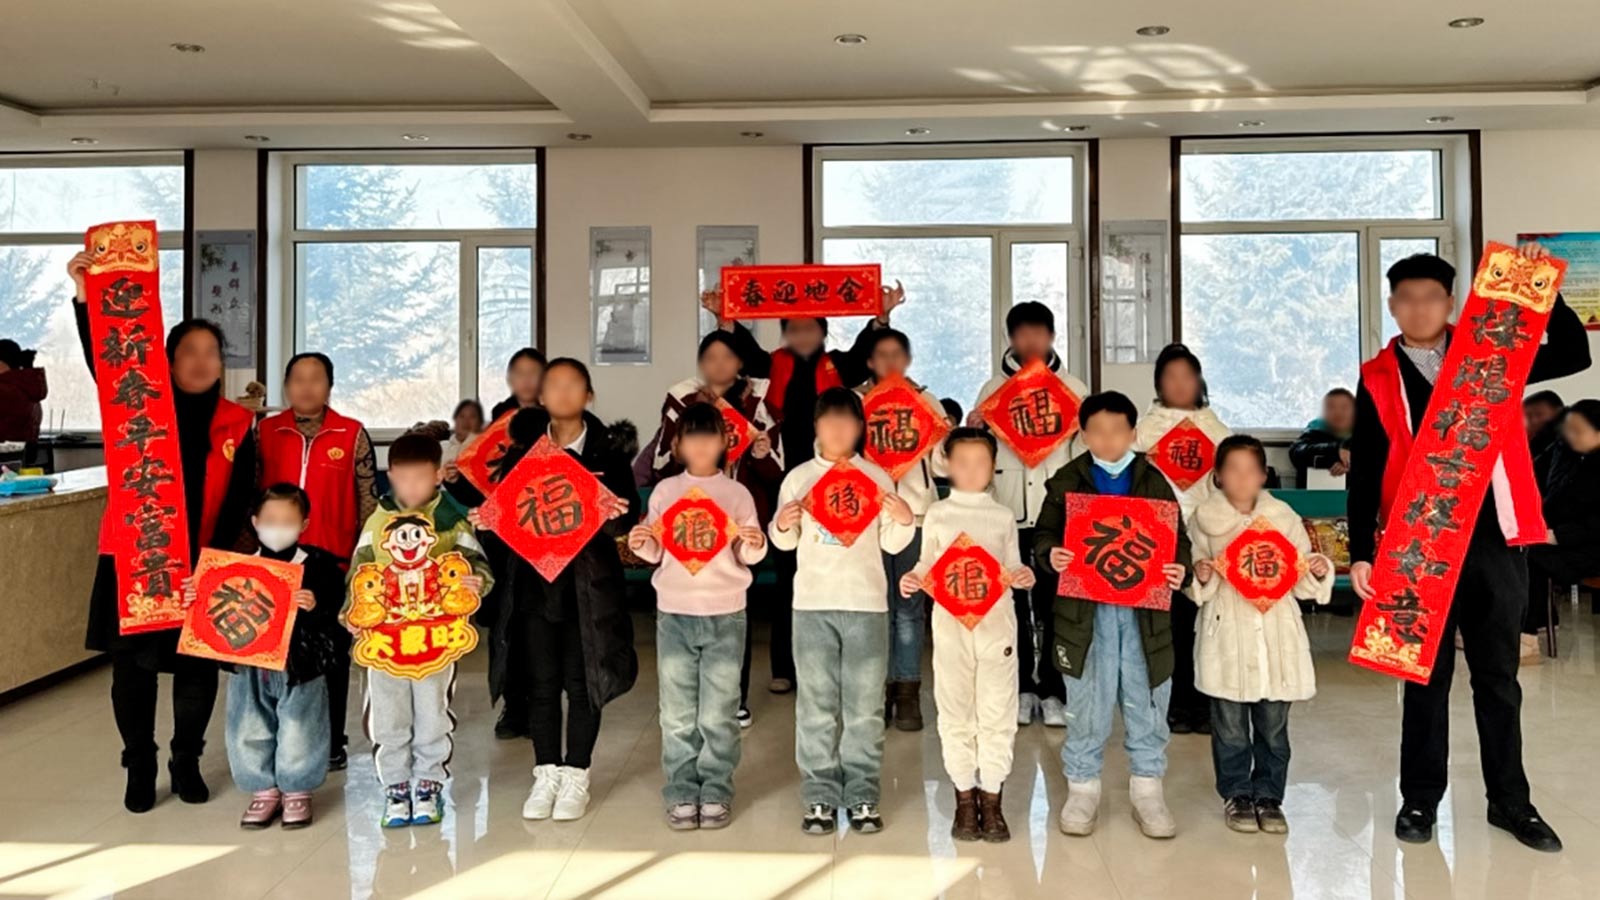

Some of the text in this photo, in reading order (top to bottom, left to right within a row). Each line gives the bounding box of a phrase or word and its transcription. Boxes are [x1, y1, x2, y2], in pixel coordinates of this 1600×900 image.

[868, 408, 920, 454] 福
[1009, 390, 1062, 438] 福
[1169, 439, 1203, 471] 福
[518, 474, 583, 537] 福
[829, 483, 860, 517] 福
[673, 511, 717, 551] 福
[1083, 515, 1157, 590] 福
[945, 560, 988, 602] 福
[1241, 544, 1279, 578] 福
[207, 578, 276, 650] 福
